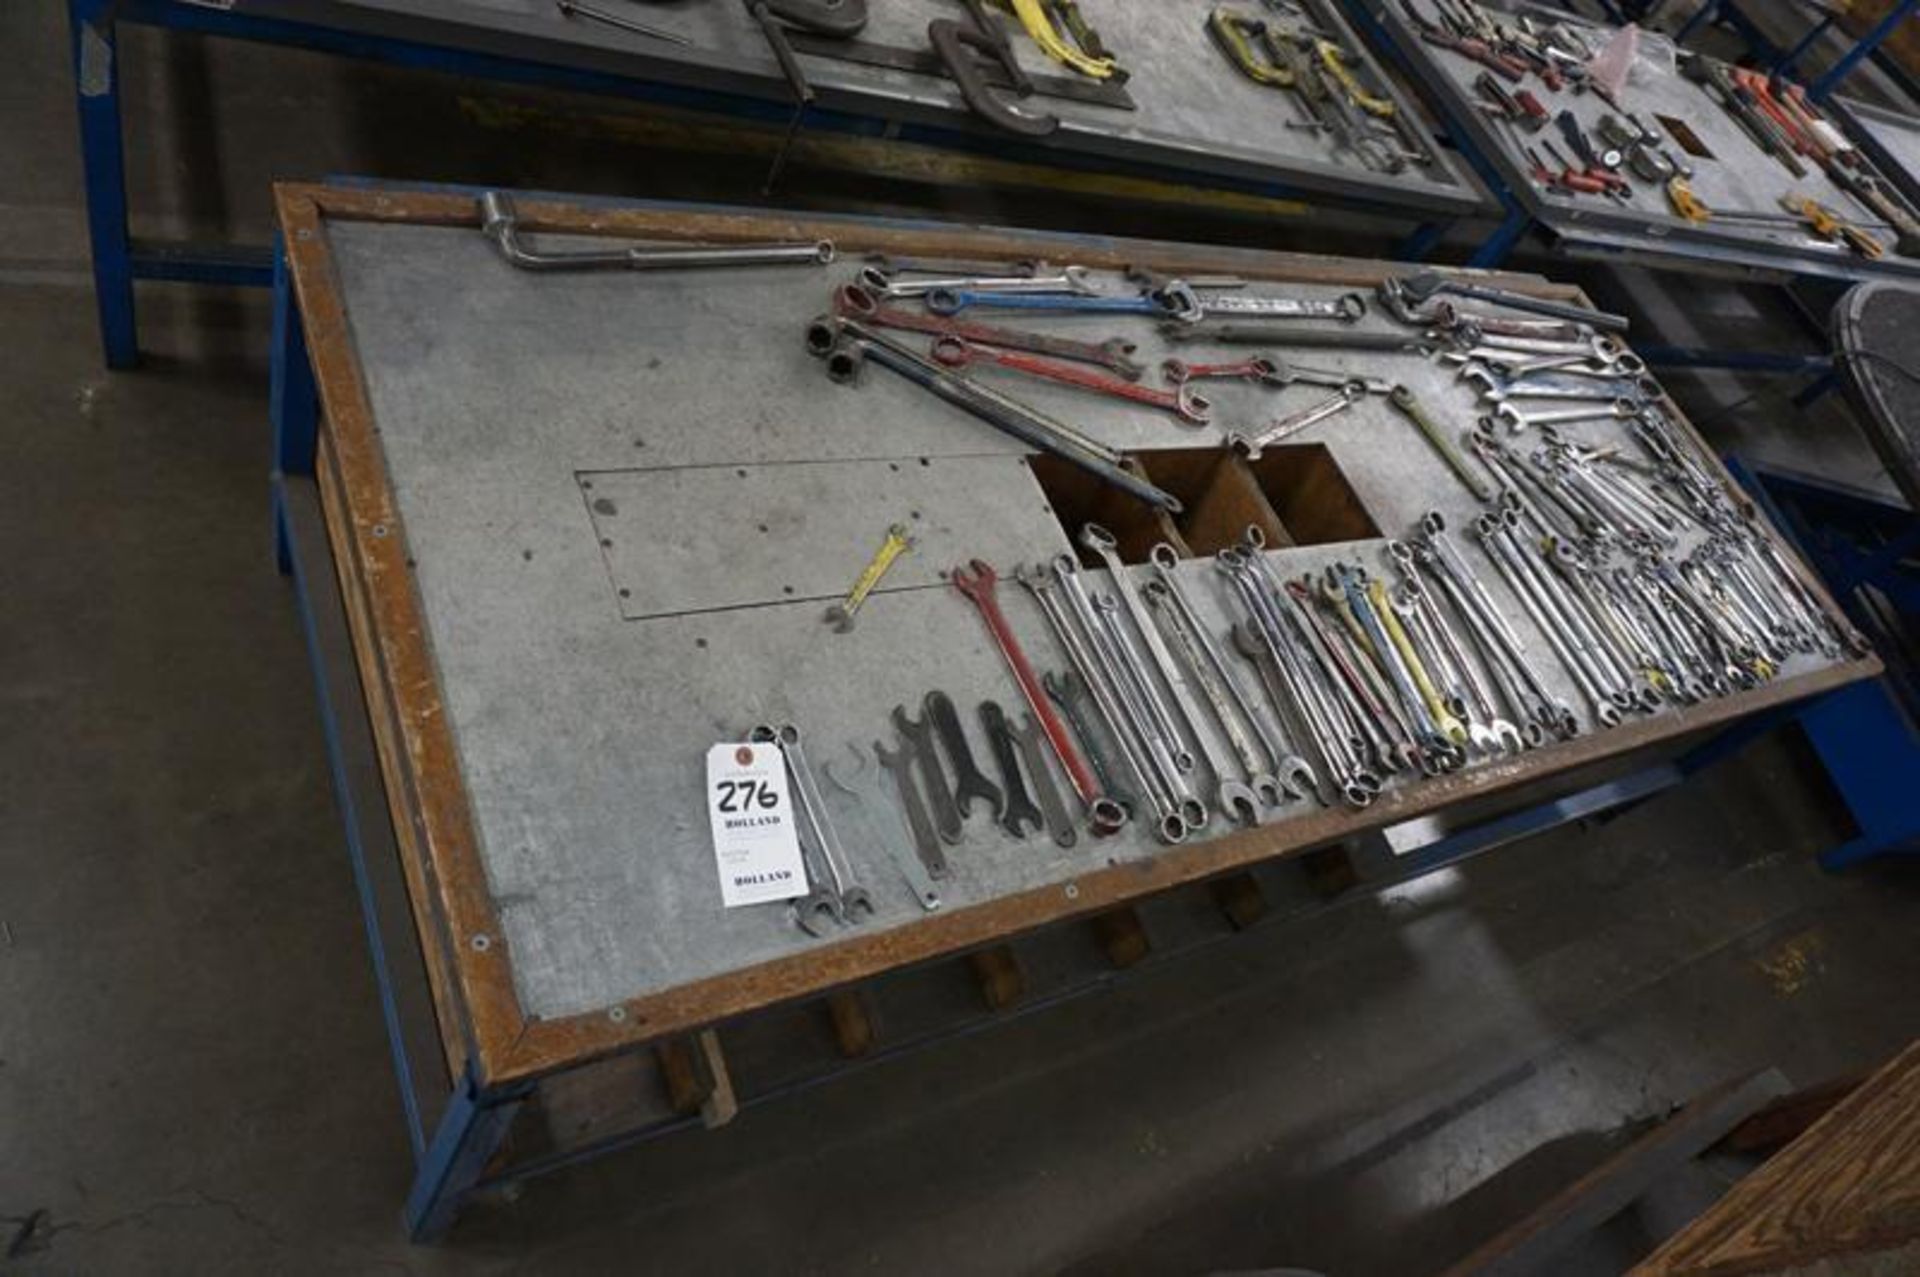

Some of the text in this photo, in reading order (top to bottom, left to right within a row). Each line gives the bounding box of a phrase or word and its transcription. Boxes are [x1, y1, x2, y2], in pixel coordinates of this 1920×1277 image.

[717, 780, 778, 812] 276
[725, 816, 780, 829] HOLLAND
[734, 870, 792, 885] HOLLAND
